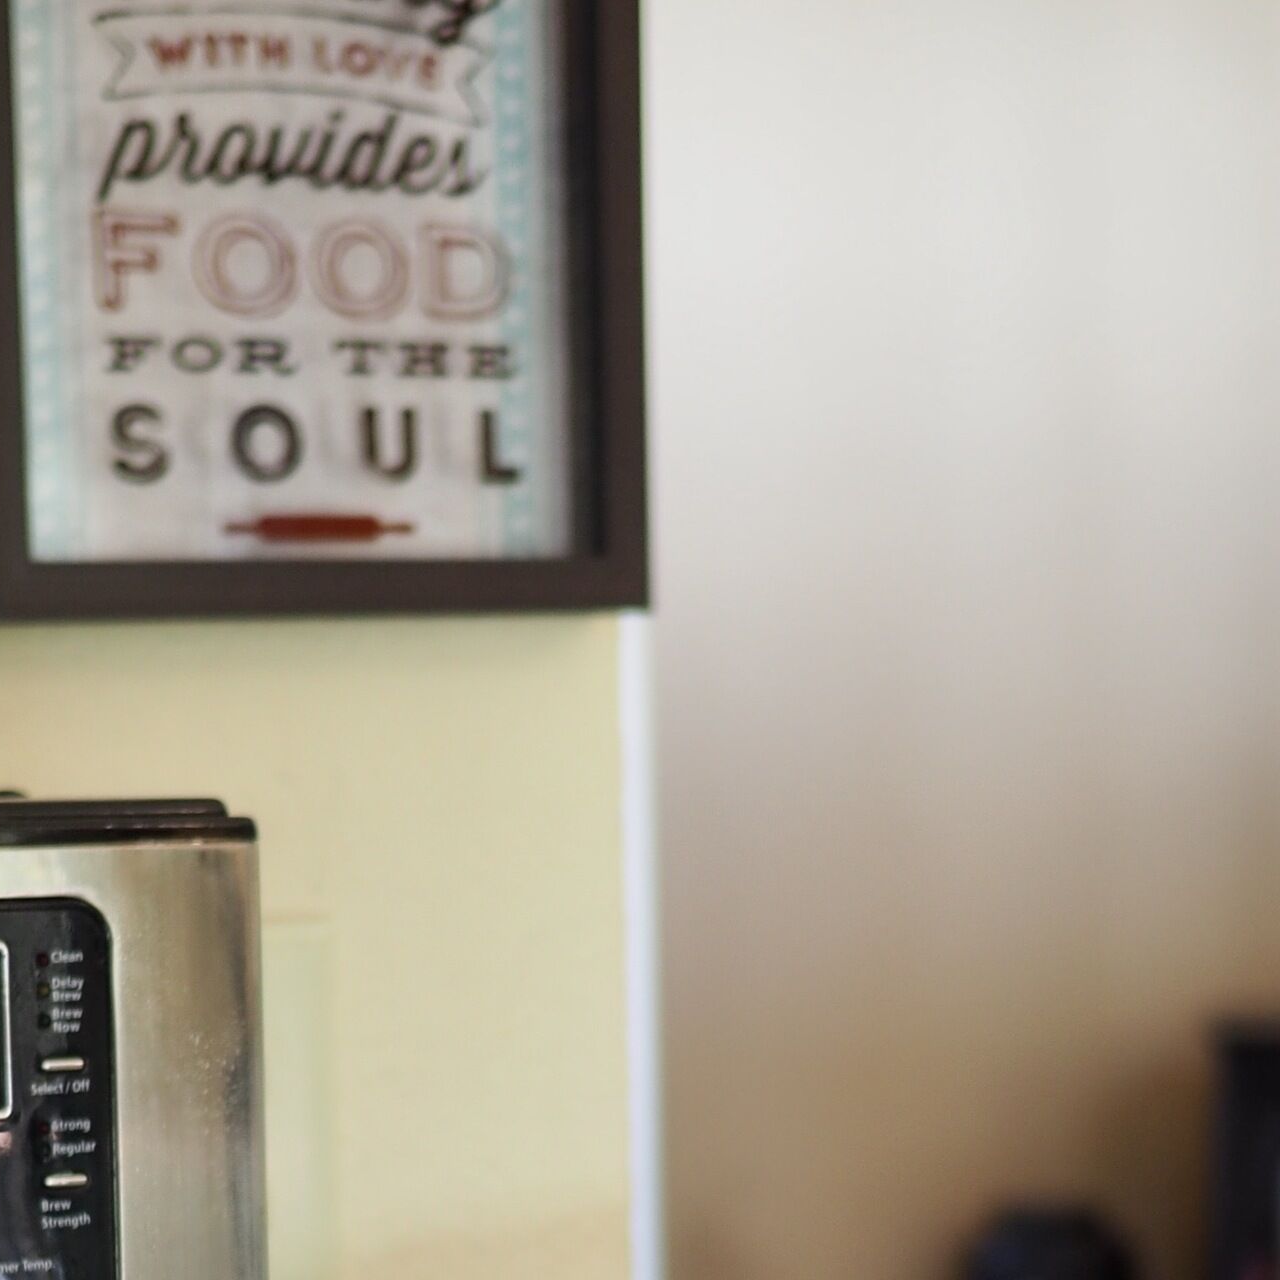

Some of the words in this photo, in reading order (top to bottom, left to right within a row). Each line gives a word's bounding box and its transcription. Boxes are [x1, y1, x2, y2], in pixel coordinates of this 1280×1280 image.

[148, 33, 289, 73] WITH
[317, 37, 437, 83] LOVE
[96, 108, 486, 202] provides
[91, 206, 514, 324] FOOD
[103, 336, 297, 377] FOR
[333, 339, 518, 381] THE
[109, 403, 524, 487] SOUL
[50, 950, 84, 965] Clean
[51, 976, 85, 991] Delay
[52, 1007, 83, 1021] Brew
[52, 1020, 81, 1034] Now
[31, 1082, 63, 1096] Select
[51, 1118, 91, 1134] Strong
[52, 1141, 97, 1157] Regular
[41, 1199, 71, 1213] Brew
[41, 1214, 91, 1230] Strength
